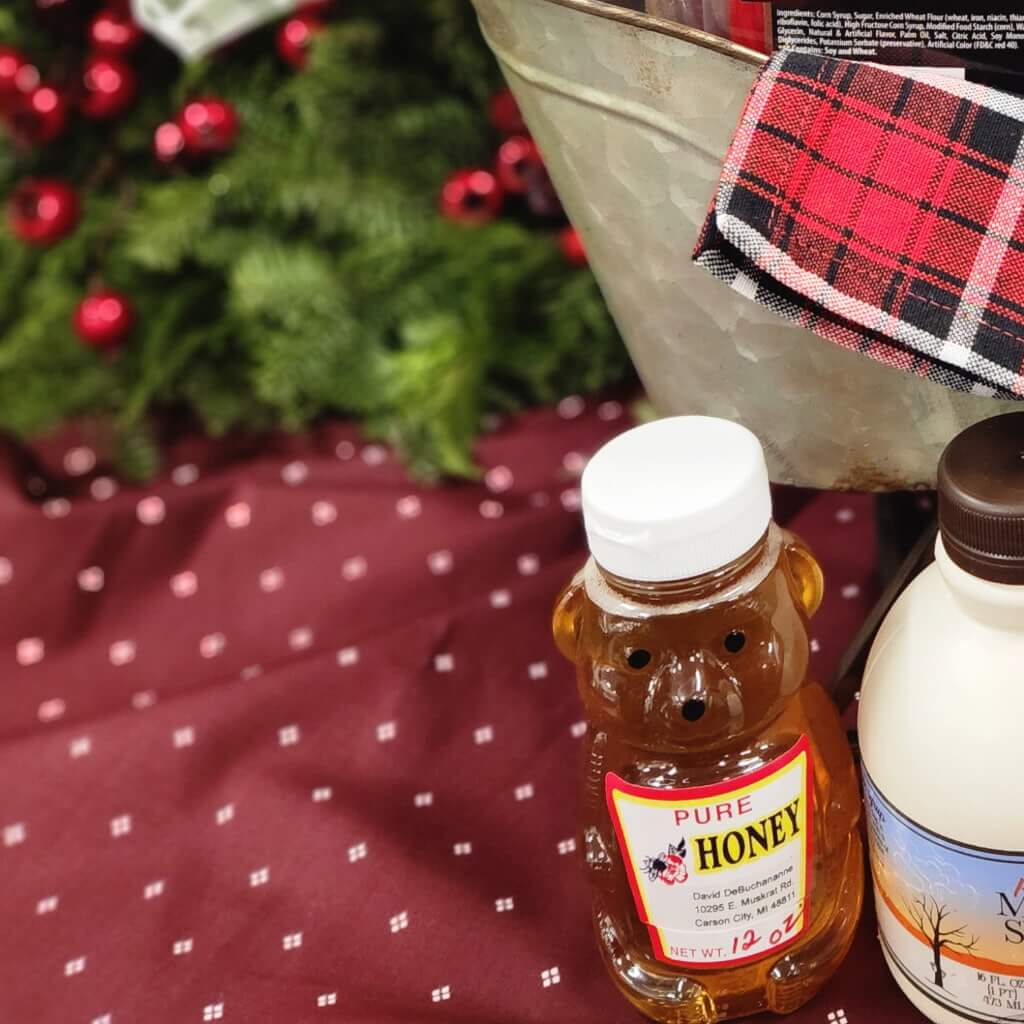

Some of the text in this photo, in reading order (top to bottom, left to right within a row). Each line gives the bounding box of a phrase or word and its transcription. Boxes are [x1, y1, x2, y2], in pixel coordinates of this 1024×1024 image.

[816, 10, 831, 19] Corn
[905, 13, 926, 21] Wheat
[927, 13, 943, 21] Flour
[889, 21, 904, 29] Corn
[926, 22, 955, 31] Modified
[956, 22, 972, 31] Food
[973, 22, 993, 31] Starch
[808, 28, 833, 37] Natural
[845, 29, 873, 38] Artificial
[927, 40, 955, 49] Artificial
[955, 40, 973, 49] Color
[994, 40, 1006, 49] red
[837, 47, 851, 55] and
[674, 795, 753, 826] PURE
[695, 797, 802, 871] HONEY
[693, 890, 721, 902] David
[695, 904, 725, 914] 10295
[740, 886, 778, 908] Muskrat
[695, 917, 731, 929] Carson
[732, 908, 755, 924] City,
[756, 904, 769, 916] MI
[669, 945, 697, 959] NET
[700, 947, 728, 959] WT.
[731, 929, 762, 955] 12
